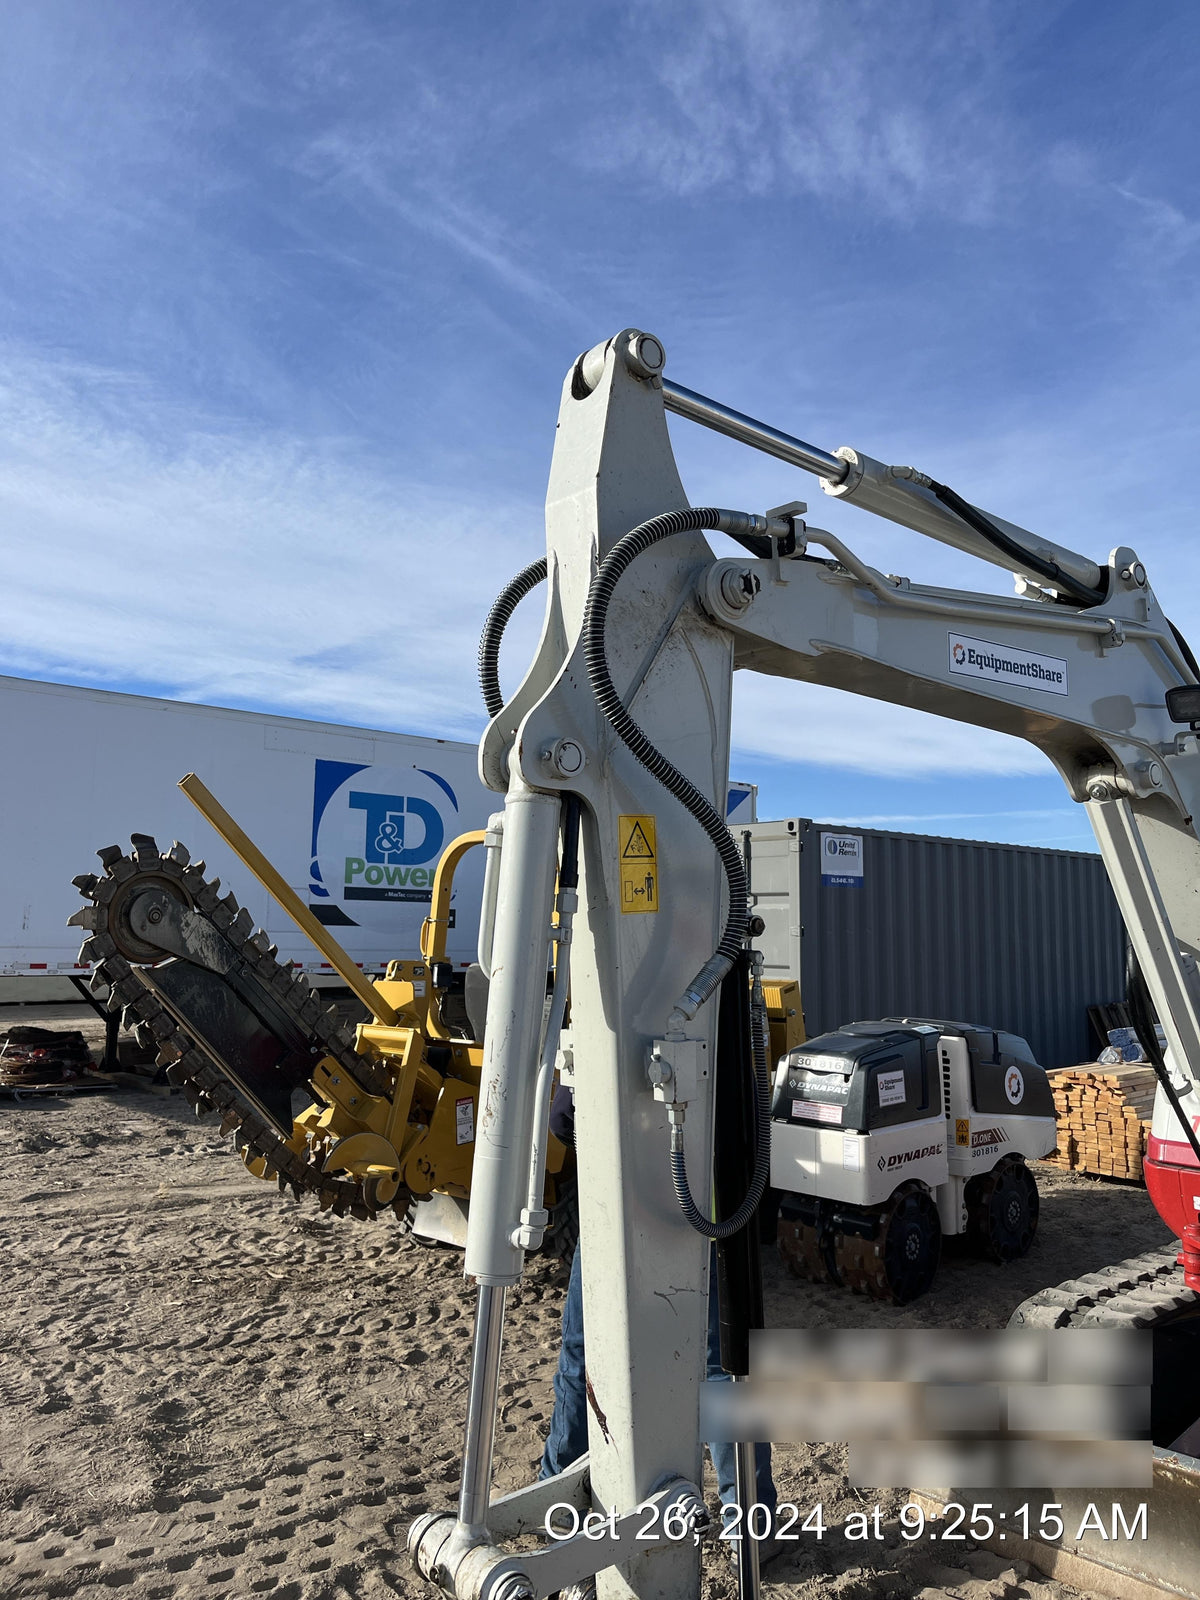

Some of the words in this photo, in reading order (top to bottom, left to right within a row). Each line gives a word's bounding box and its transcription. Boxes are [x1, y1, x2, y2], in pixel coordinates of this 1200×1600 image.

[967, 648, 1063, 684] EquipmentShare
[349, 790, 444, 866] T&D
[796, 1081, 849, 1095] DYNAPAC
[887, 1143, 944, 1167] DYNAPAC
[971, 1145, 999, 1158] 301816
